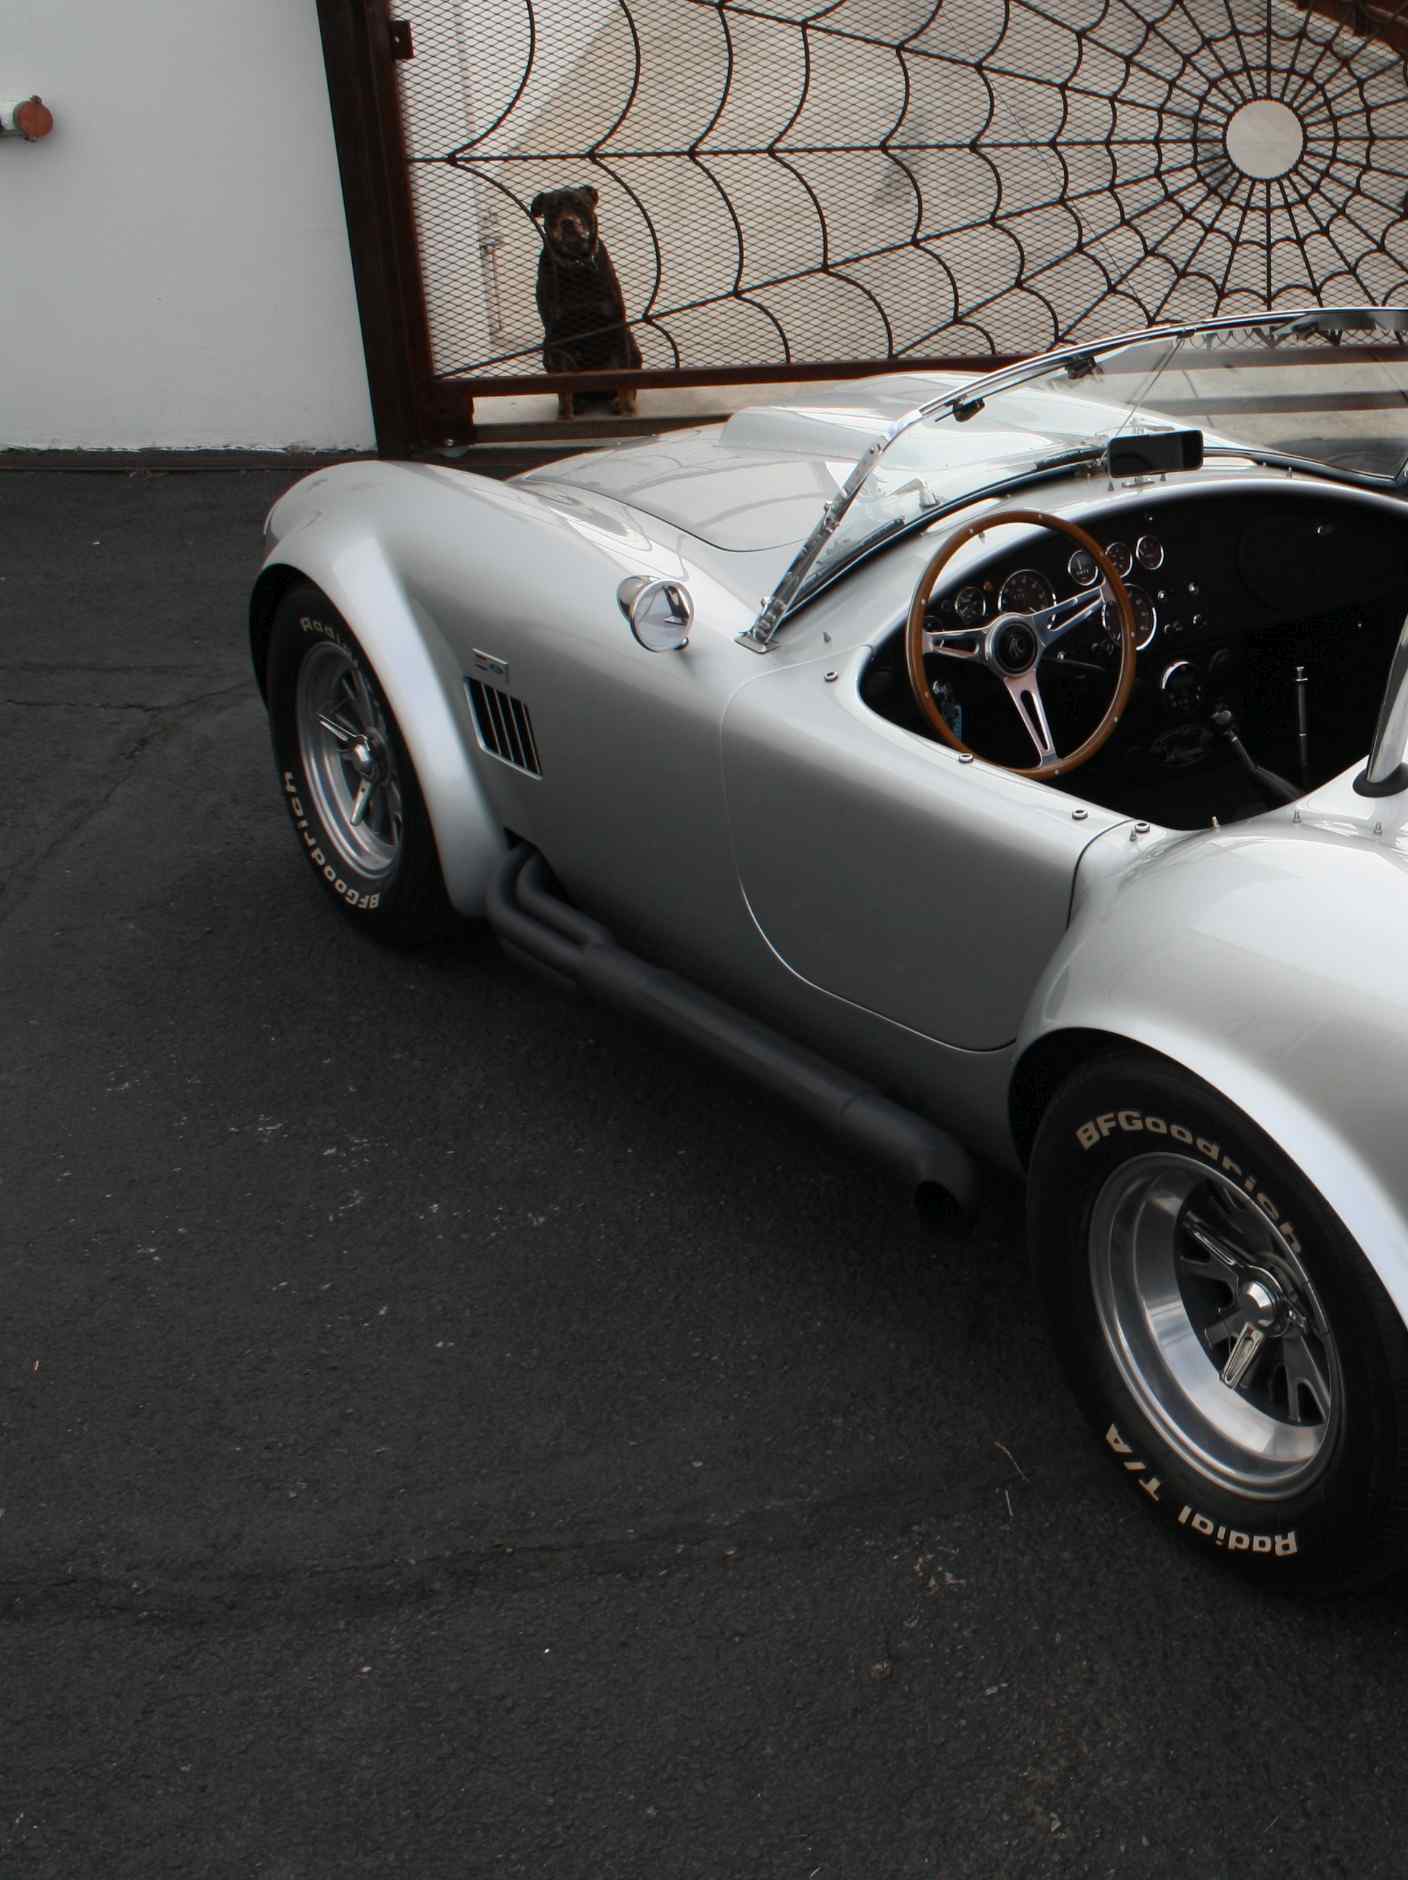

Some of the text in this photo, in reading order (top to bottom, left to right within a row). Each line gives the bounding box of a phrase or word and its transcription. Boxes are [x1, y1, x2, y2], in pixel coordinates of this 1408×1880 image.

[283, 770, 381, 910] BFGoodrich
[1075, 1110, 1302, 1253] BFGoodrich
[1105, 1423, 1298, 1557] Radial T/A
